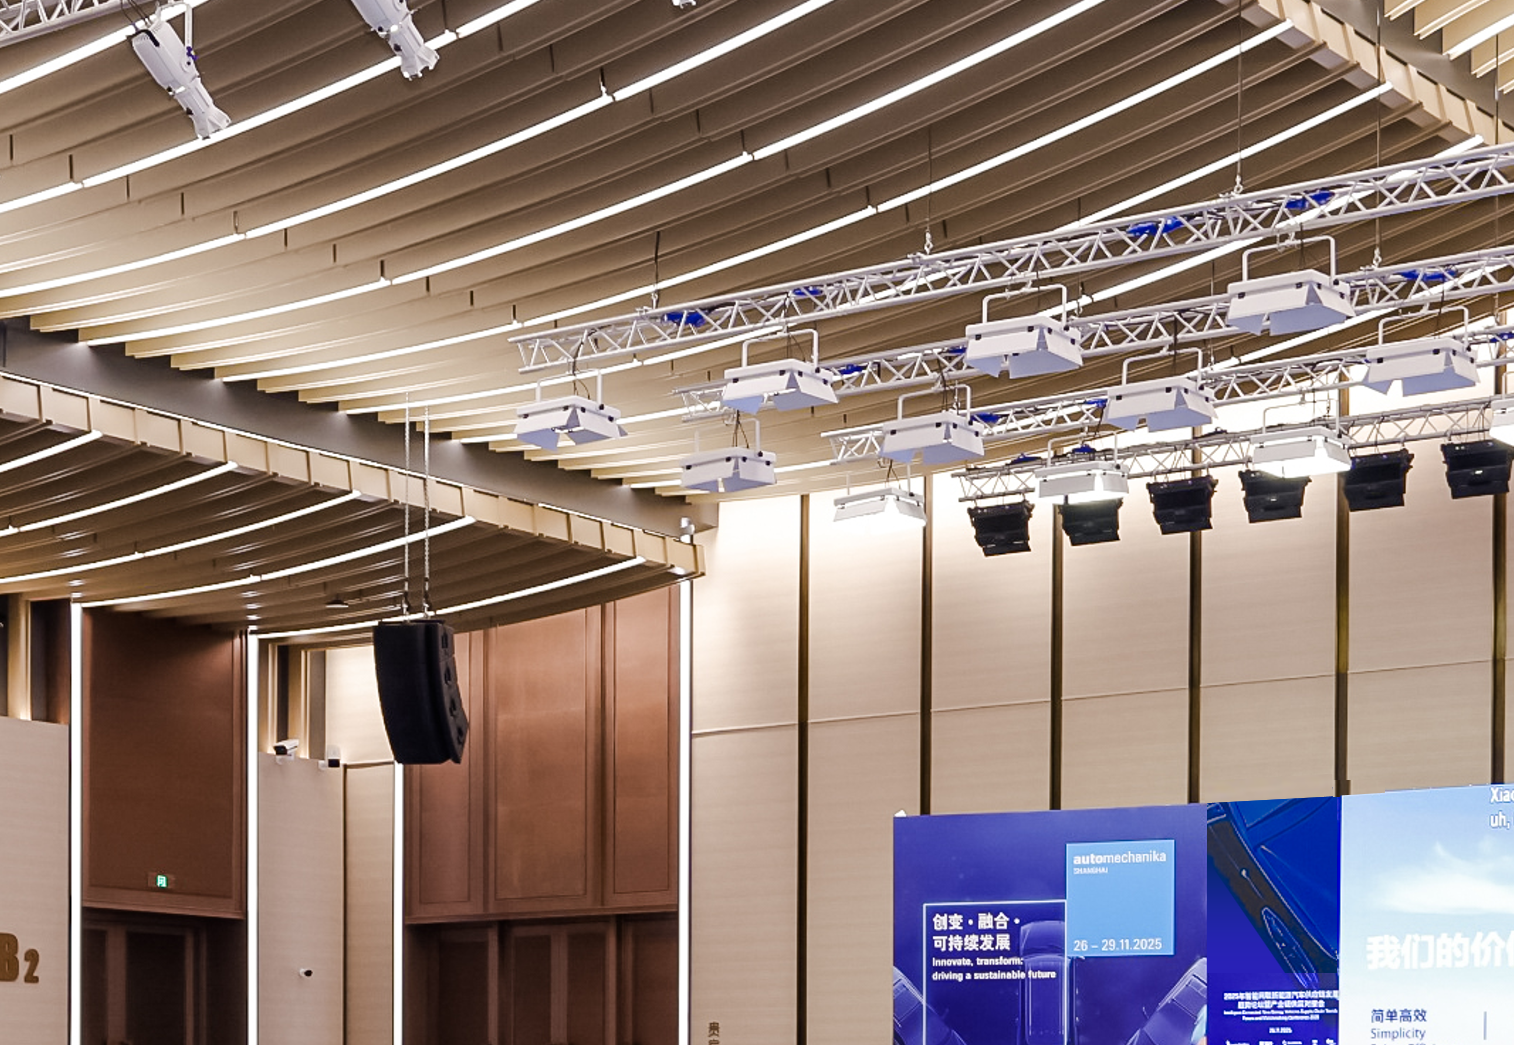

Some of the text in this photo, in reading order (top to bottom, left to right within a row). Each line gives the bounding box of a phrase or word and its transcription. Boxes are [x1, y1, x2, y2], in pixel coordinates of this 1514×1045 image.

[1490, 811, 1510, 829] uh,
[1073, 850, 1167, 865] automechanika
[933, 934, 1011, 951] 可持续发展
[1073, 940, 1088, 951] 26
[1101, 938, 1163, 951] 29.11.2025
[932, 956, 1023, 967] Innovate, transform:
[932, 969, 1057, 982] driving a sustainable future
[1370, 1008, 1428, 1023] 简单高效
[1370, 1027, 1426, 1041] Simplicity
